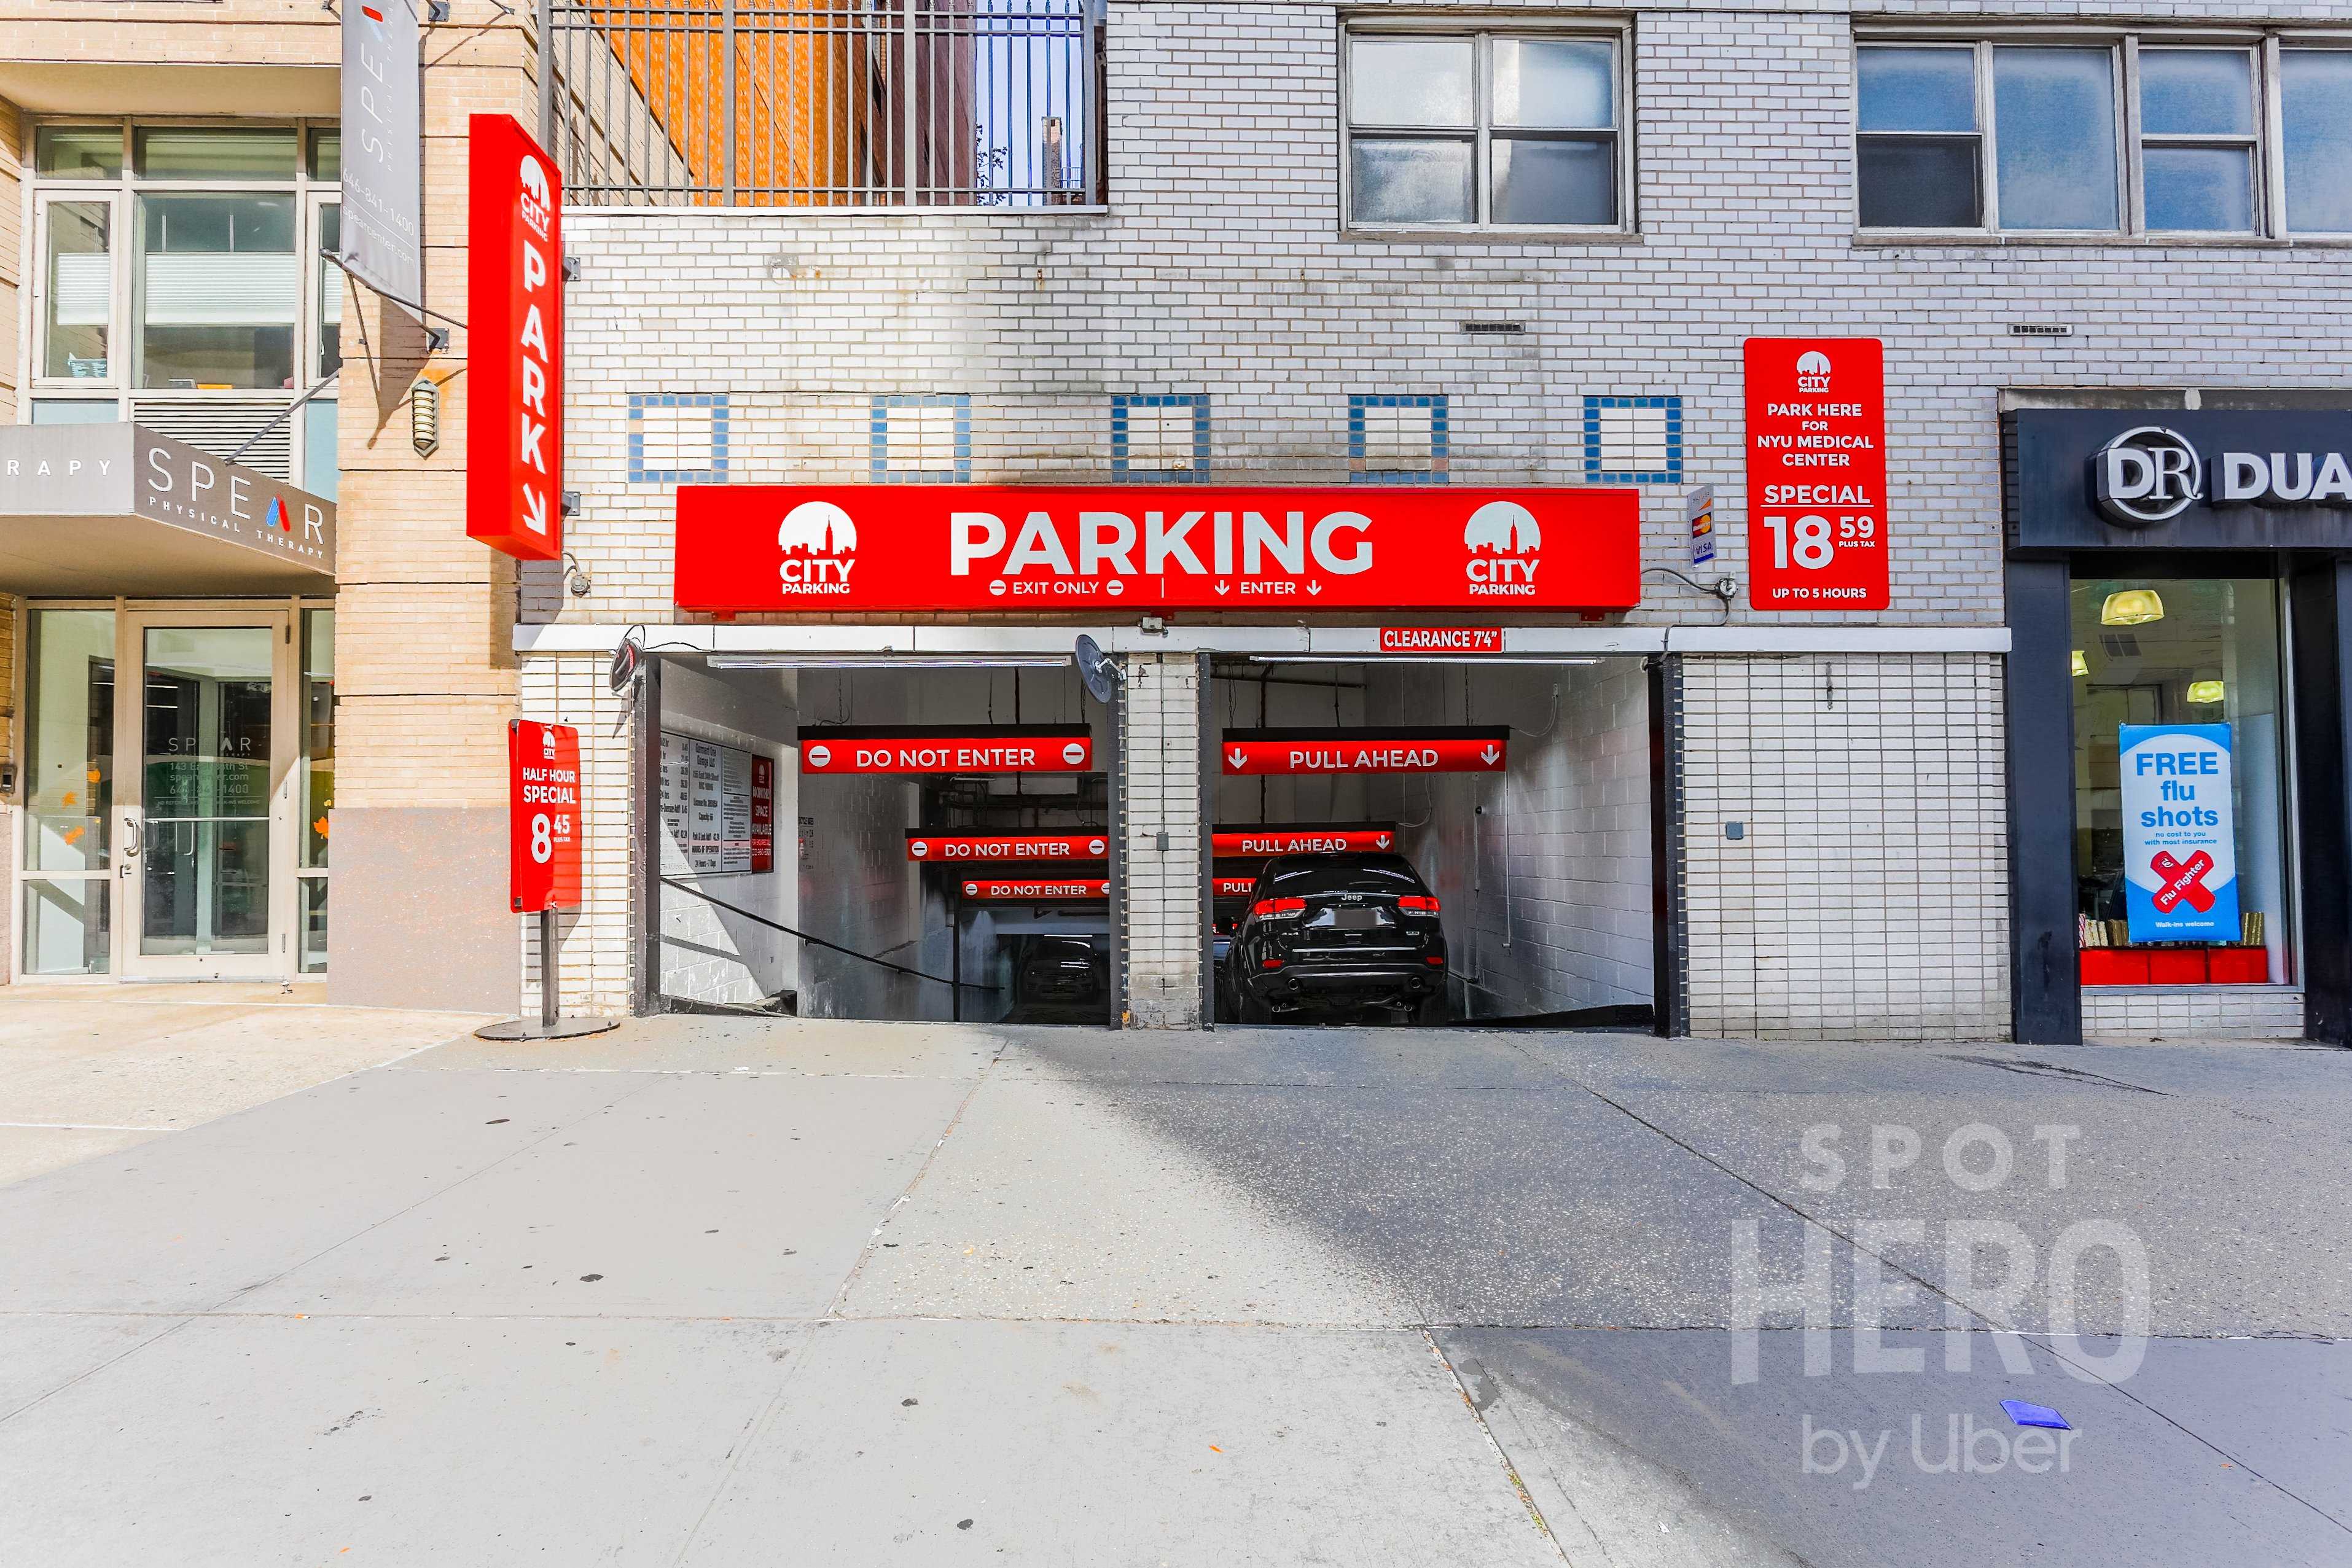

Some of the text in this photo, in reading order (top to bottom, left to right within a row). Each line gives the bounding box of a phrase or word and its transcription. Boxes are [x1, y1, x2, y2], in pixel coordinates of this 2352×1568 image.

[343, 168, 414, 236] 646-841-1400
[520, 192, 550, 232] CITY
[522, 210, 548, 242] PARKING
[520, 240, 549, 475] PARK
[1797, 376, 1831, 388] CITY
[1767, 404, 1862, 416] PARK HERE
[1802, 421, 1829, 431] FOR
[1757, 435, 1874, 448] NYU MEDICAL
[7, 459, 112, 476] RAPY
[1782, 453, 1850, 466] CENTER
[2223, 452, 2352, 501] DUA
[147, 447, 324, 545] SPEAR
[1764, 485, 1870, 504] SPECIAL
[149, 496, 324, 560] PHYSICAL THERAPY
[950, 511, 1373, 576] PARKING
[1695, 542, 1713, 555] VISA
[779, 558, 856, 583] CITY
[1466, 558, 1540, 583] CITY
[782, 583, 851, 595] PARKING
[1013, 581, 1099, 595] EXIT ONLY
[1240, 582, 1296, 595] ENTER
[1469, 583, 1536, 596] PARKING
[1772, 588, 1867, 599] UP TO 5 HOURS
[1384, 630, 1471, 648] CLEARANCE
[543, 747, 556, 756] CITY
[856, 748, 1036, 767] DO NOT ENTER
[1290, 749, 1439, 768] PULL AHEAD
[2136, 751, 2219, 776] FREE
[170, 774, 249, 783] spearer.com
[523, 767, 576, 783] HALF HOUR
[170, 784, 249, 794] 64-4-1400
[523, 785, 576, 804] SPECIAL
[2160, 781, 2195, 802] flu
[2141, 806, 2219, 827] shots
[531, 813, 571, 864] 8 45
[1242, 838, 1347, 852] PULL AHEAD
[945, 843, 1070, 856] DO NOT ENTER
[991, 885, 1087, 895] DO NOT ENTER
[2160, 889, 2177, 905] Flu
[2173, 859, 2206, 891] Fighter
[1342, 893, 1362, 902] Jeep
